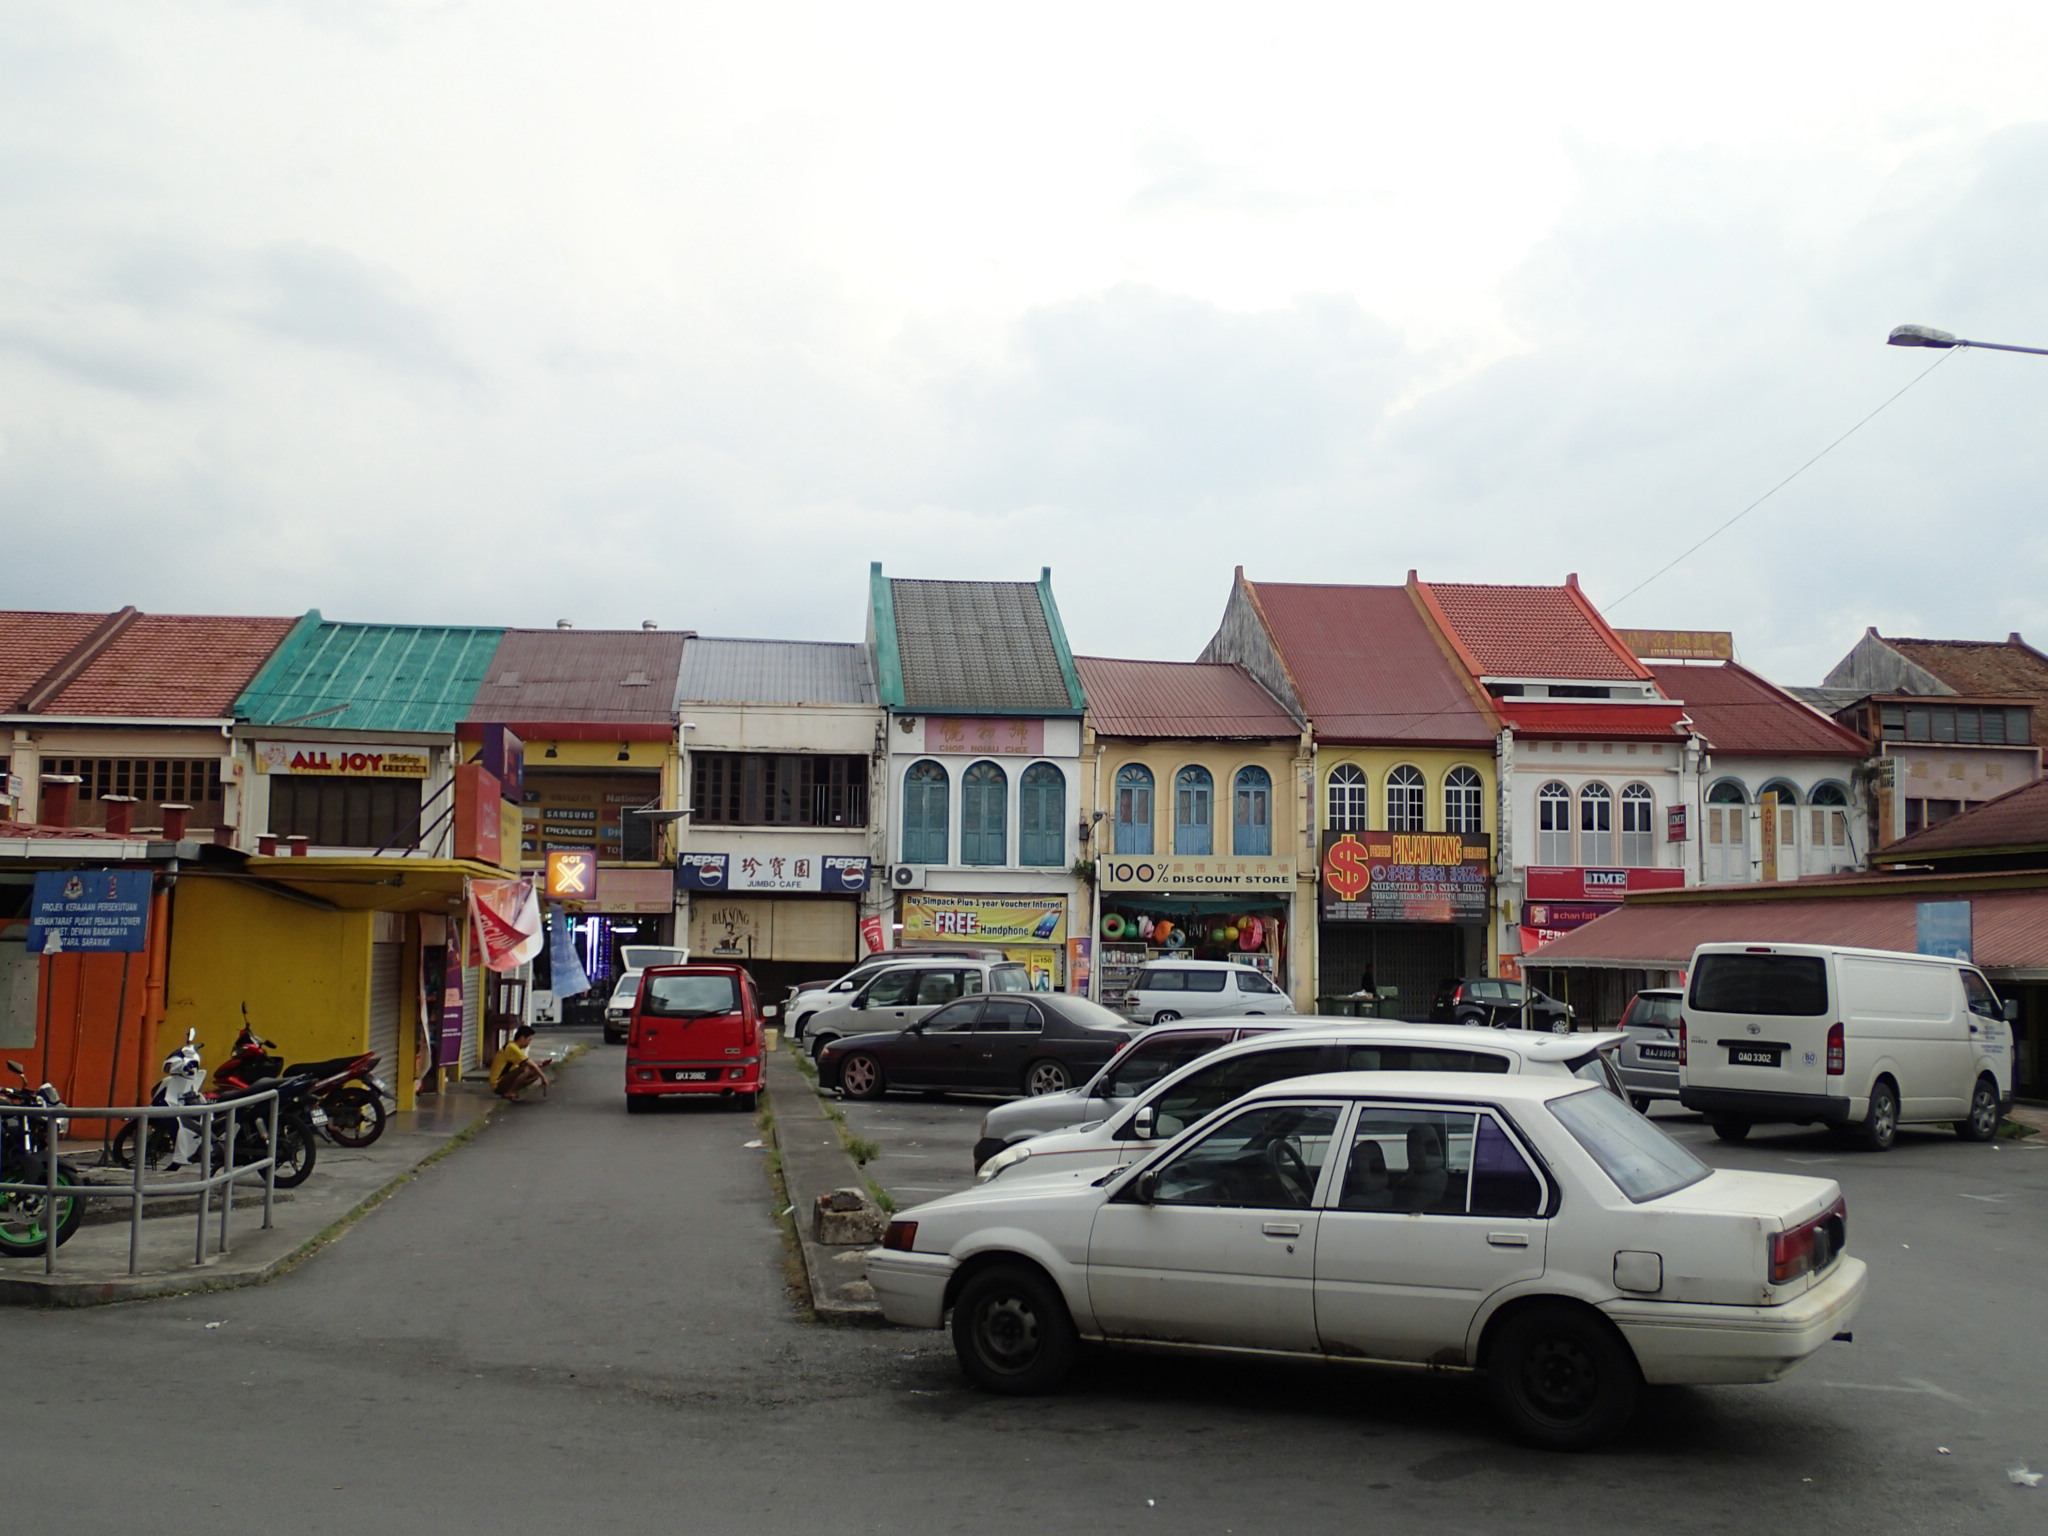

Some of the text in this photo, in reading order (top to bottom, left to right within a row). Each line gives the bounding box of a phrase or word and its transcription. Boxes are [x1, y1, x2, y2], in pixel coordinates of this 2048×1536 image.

[291, 751, 332, 770] ALL
[339, 753, 383, 772] JOY
[546, 810, 594, 819] SAMSUNG
[545, 826, 593, 836] PIONEER
[1393, 835, 1430, 865] PINJAM
[1432, 836, 1462, 865] WANG
[561, 856, 581, 864] GOT
[682, 855, 725, 867] PEPSI
[825, 857, 867, 870] PEPSI
[556, 862, 585, 892] X
[1108, 863, 1169, 883] 100%
[1245, 876, 1289, 884] STORE
[1592, 872, 1625, 885] IME
[747, 880, 802, 888] JUMBO CAFE
[42, 903, 137, 911] PROJEK KERAJAAN PERSEKUTUAN
[907, 896, 921, 906] Buy
[923, 897, 955, 908] Simpack
[957, 898, 973, 907] Plus
[982, 901, 998, 909] year
[1000, 899, 1031, 909] Voucher
[1033, 900, 1062, 909] Internet
[1560, 911, 1597, 920] chan fatt
[74, 917, 93, 925] PUSAT
[120, 917, 141, 925] TOWER
[935, 911, 977, 934] FREE
[71, 927, 91, 936] DEWAN
[980, 925, 1029, 936] Handphone
[81, 938, 111, 947] SARAWAK
[1040, 956, 1052, 964] 150
[1753, 1054, 1771, 1063] 3302
